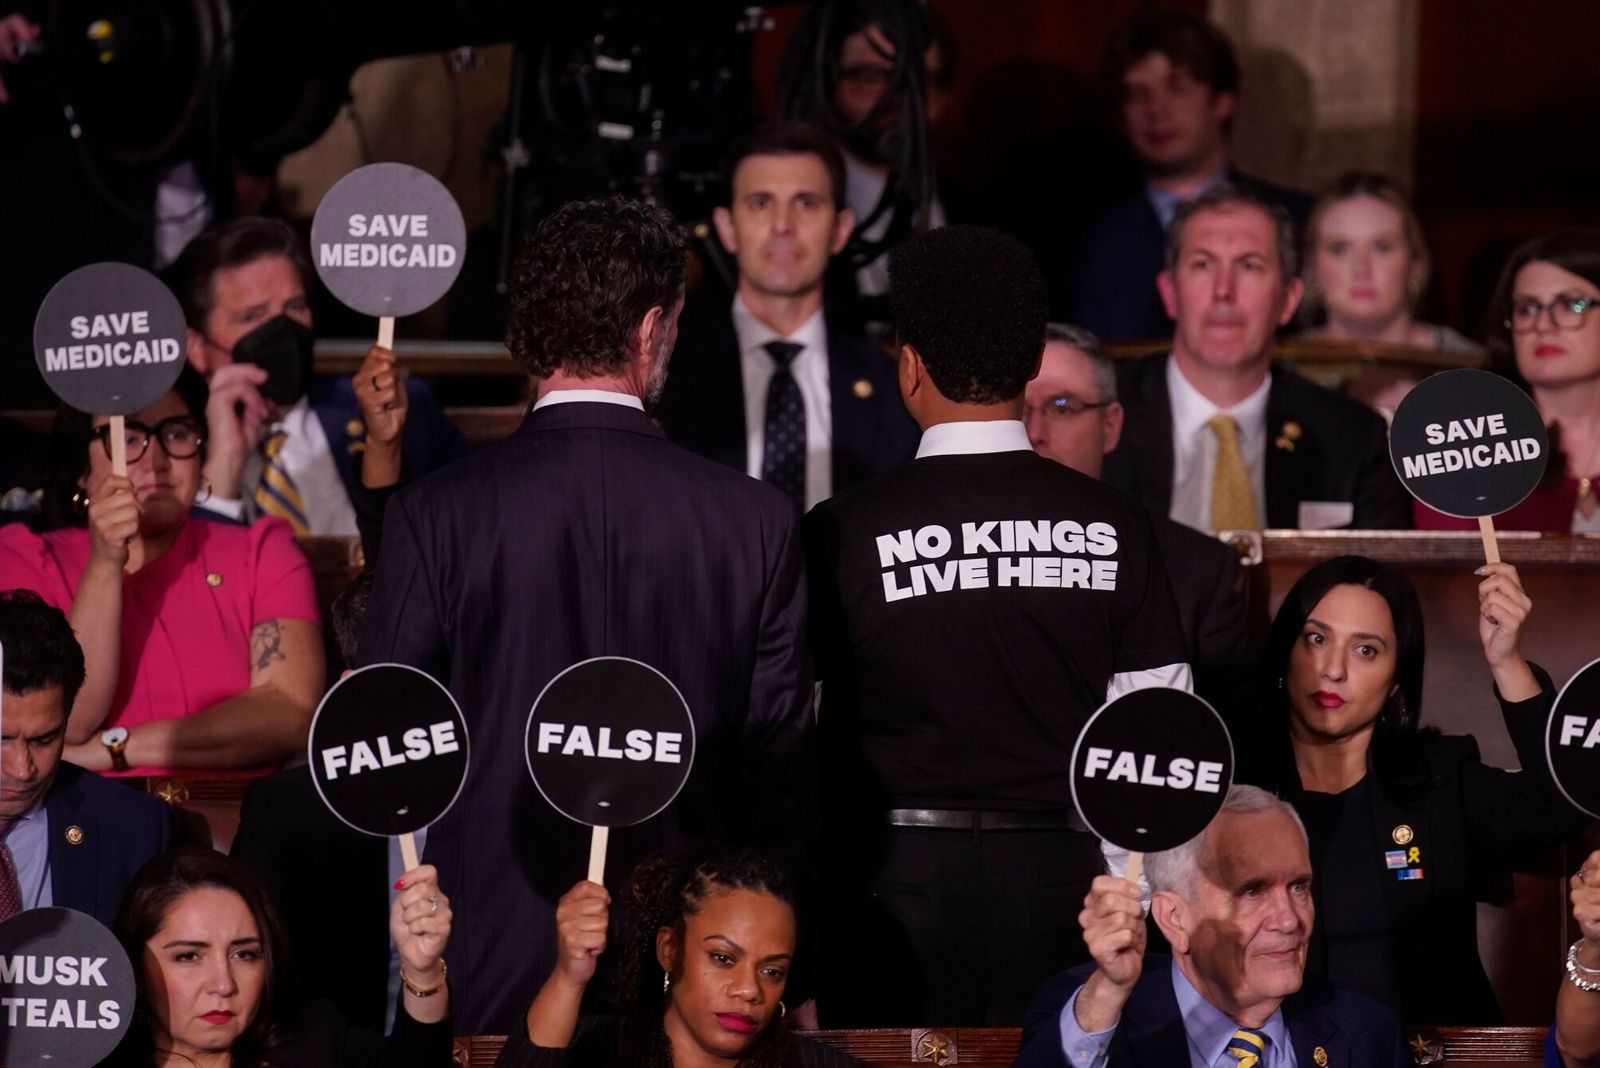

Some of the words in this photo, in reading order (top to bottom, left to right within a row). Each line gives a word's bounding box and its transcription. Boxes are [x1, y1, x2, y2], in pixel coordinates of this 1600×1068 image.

[348, 214, 428, 238] SAVE
[319, 243, 456, 268] MEDICAID
[70, 311, 150, 339] SAVE
[45, 338, 180, 372] MEDICAID
[1425, 413, 1508, 445] SAVE
[1402, 437, 1541, 479] MEDICAID
[875, 524, 953, 568] NO
[961, 520, 1119, 556] KINGS
[881, 557, 990, 603] LIVE
[997, 556, 1119, 591] HERE
[322, 720, 460, 780] FALSE
[536, 722, 683, 764] FALSE
[1084, 747, 1224, 793] FALSE
[0, 955, 108, 987] MUSK
